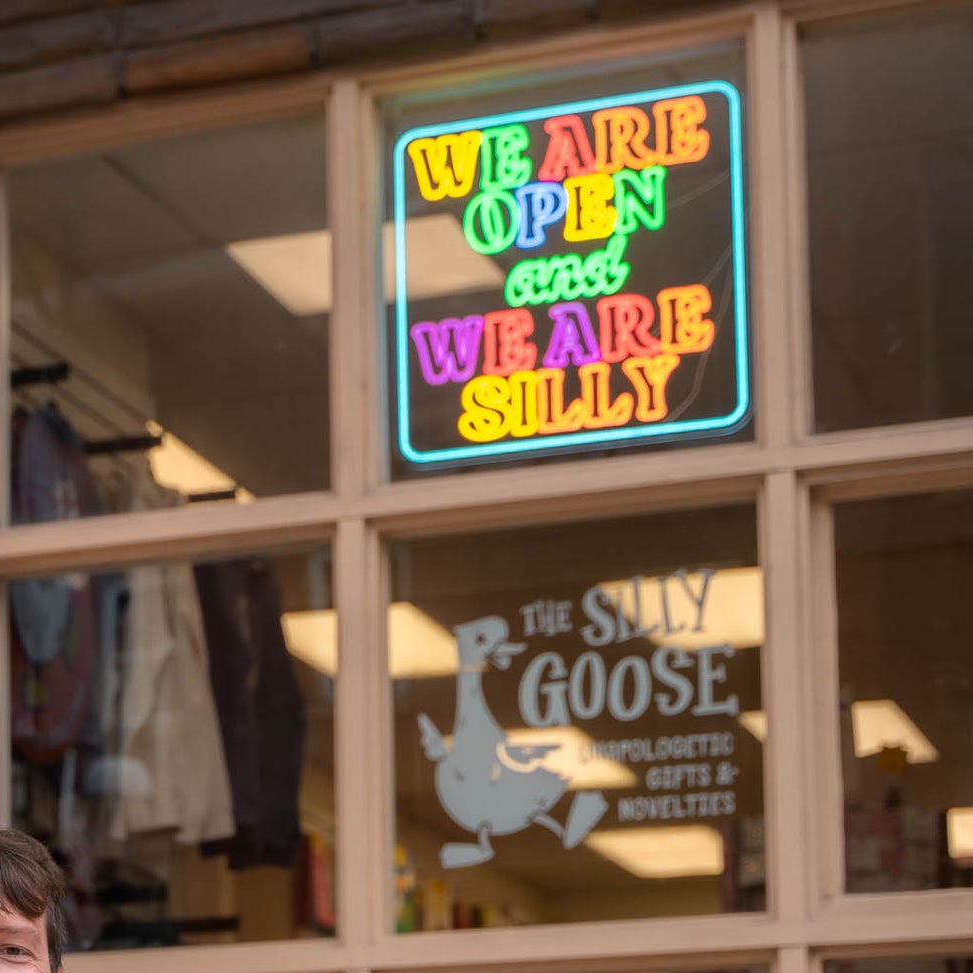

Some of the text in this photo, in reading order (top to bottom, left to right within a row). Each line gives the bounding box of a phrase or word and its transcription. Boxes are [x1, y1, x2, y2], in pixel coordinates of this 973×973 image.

[407, 95, 710, 201] WE ARE
[463, 165, 667, 254] OPEN
[505, 233, 630, 307] and
[410, 284, 715, 385] WE ARE
[457, 354, 681, 442] SILLY
[519, 568, 718, 646] THE SILLY
[518, 642, 739, 728] GOOSE
[618, 790, 736, 821] NOVELTIES
[646, 761, 739, 790] GIFTS &
